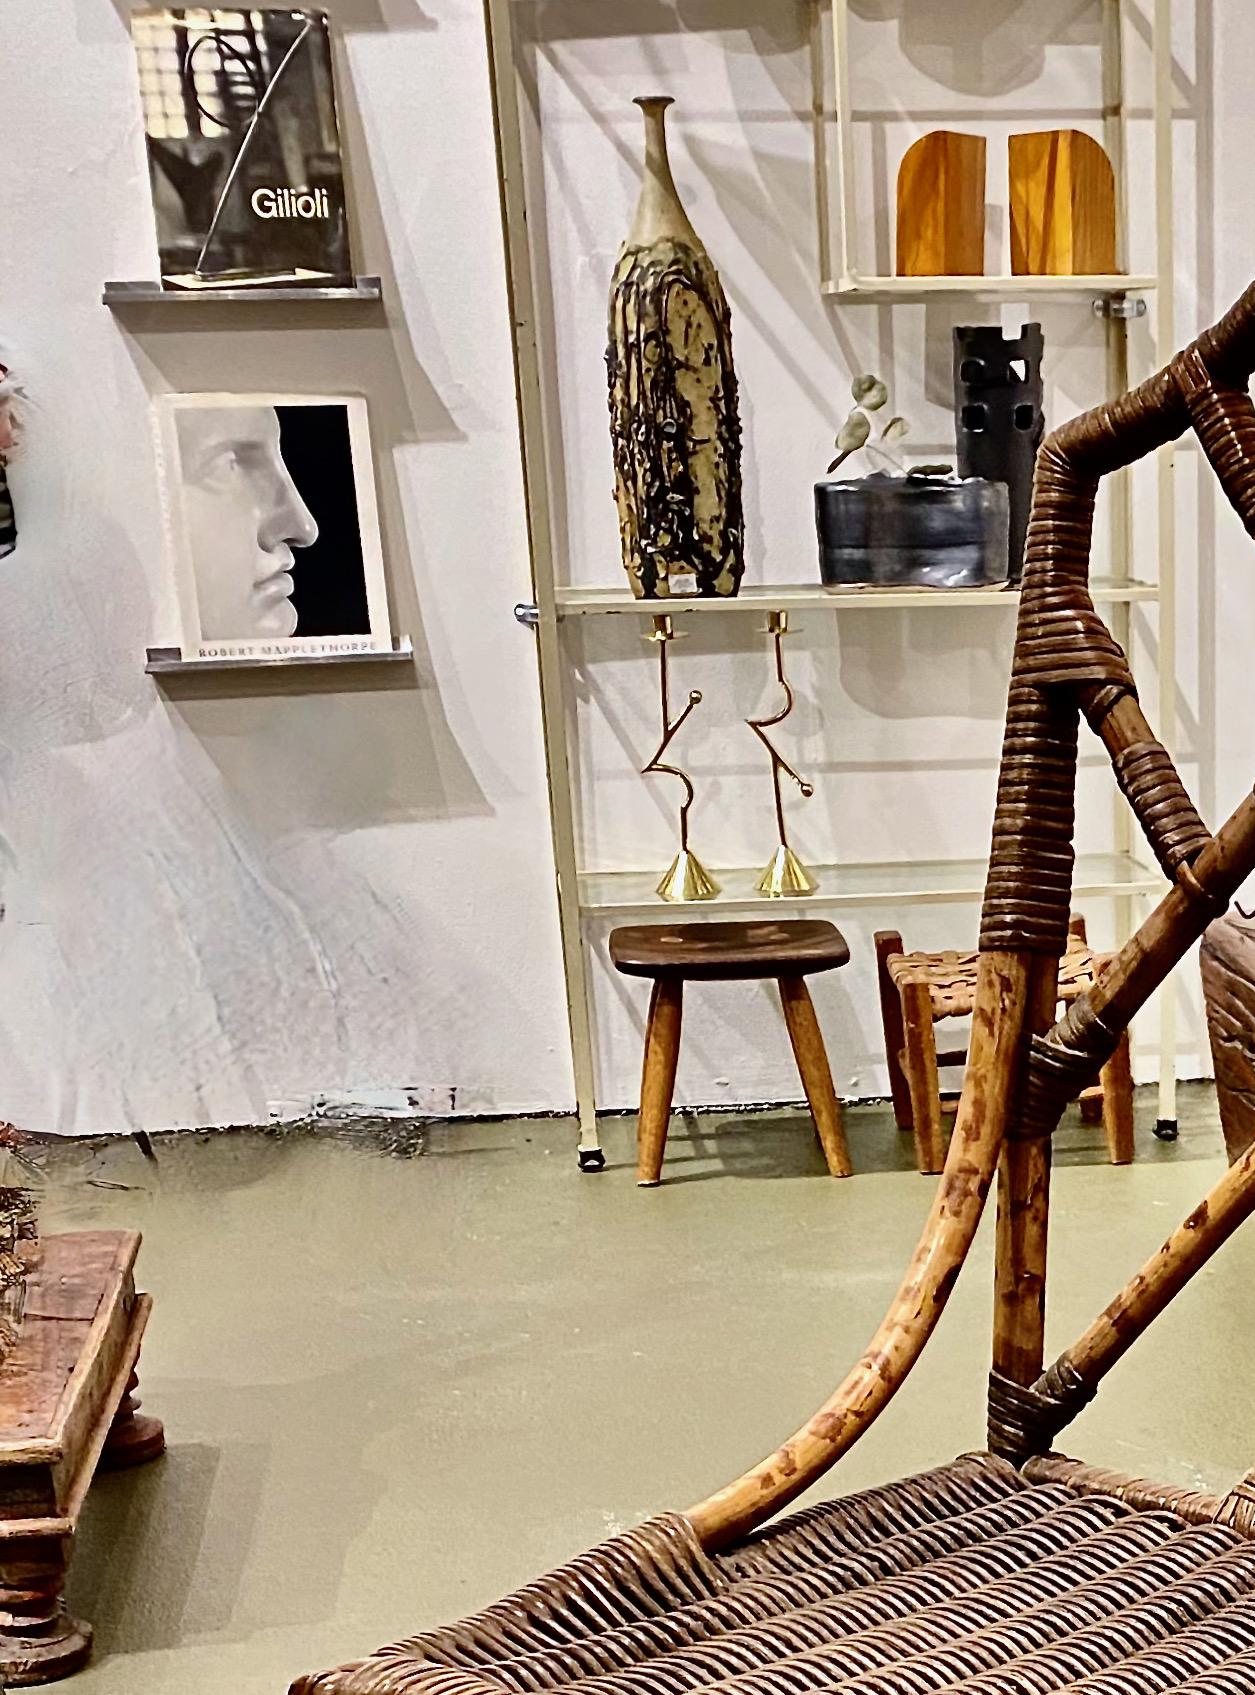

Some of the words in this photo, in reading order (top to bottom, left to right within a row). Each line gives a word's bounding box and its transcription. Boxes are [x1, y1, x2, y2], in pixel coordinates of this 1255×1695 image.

[251, 188, 329, 218] Gilioli
[199, 647, 254, 658] ROBERT
[261, 641, 376, 655] MAPPLETHORPE
